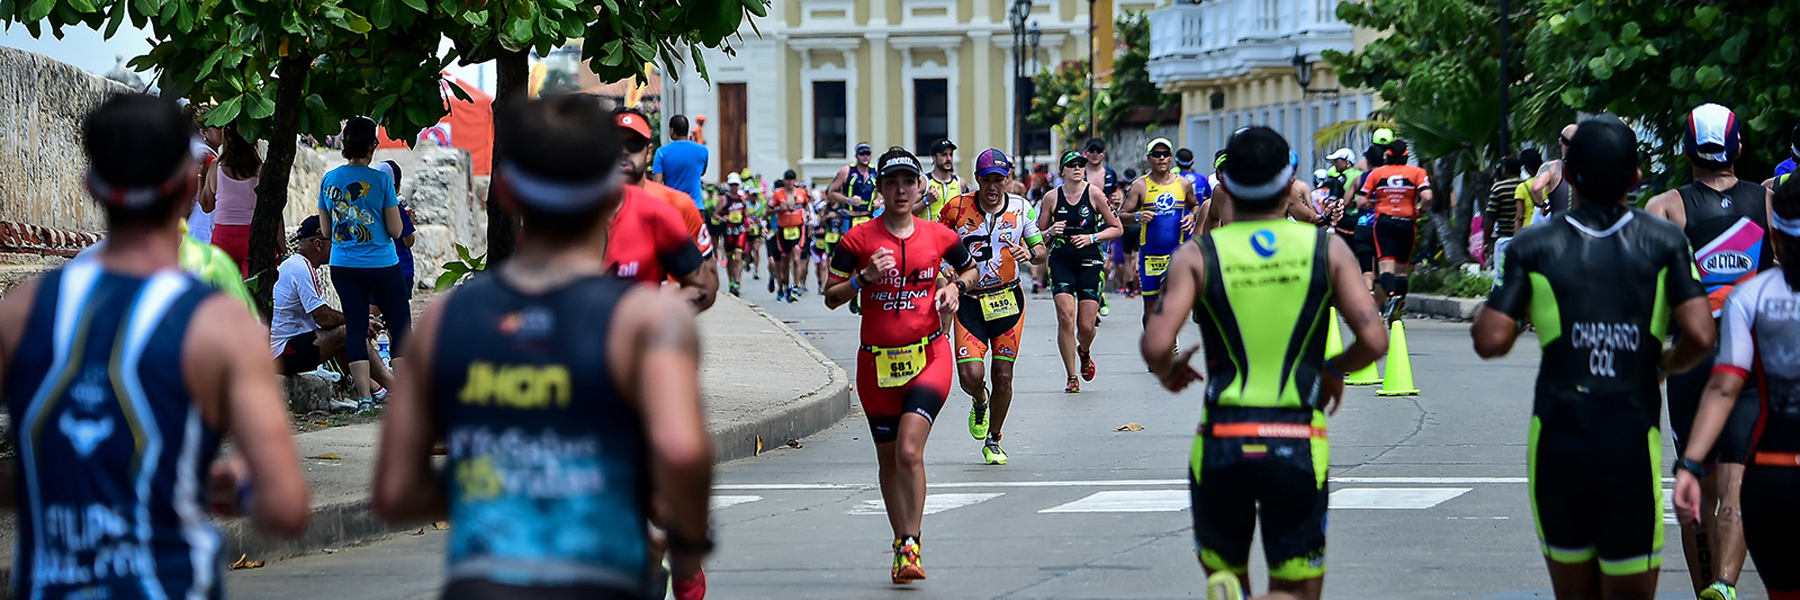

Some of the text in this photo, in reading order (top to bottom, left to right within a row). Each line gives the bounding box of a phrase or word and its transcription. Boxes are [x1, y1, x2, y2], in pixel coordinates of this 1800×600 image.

[1387, 174, 1404, 188] G
[1720, 252, 1749, 270] CYCLING
[870, 289, 928, 301] HELENA
[883, 300, 916, 311] COL
[989, 298, 1010, 309] 1430
[1571, 322, 1641, 352] CHAPARRO
[890, 360, 912, 372] 681
[1589, 348, 1616, 377] COL
[1257, 423, 1310, 439] GATORADE
